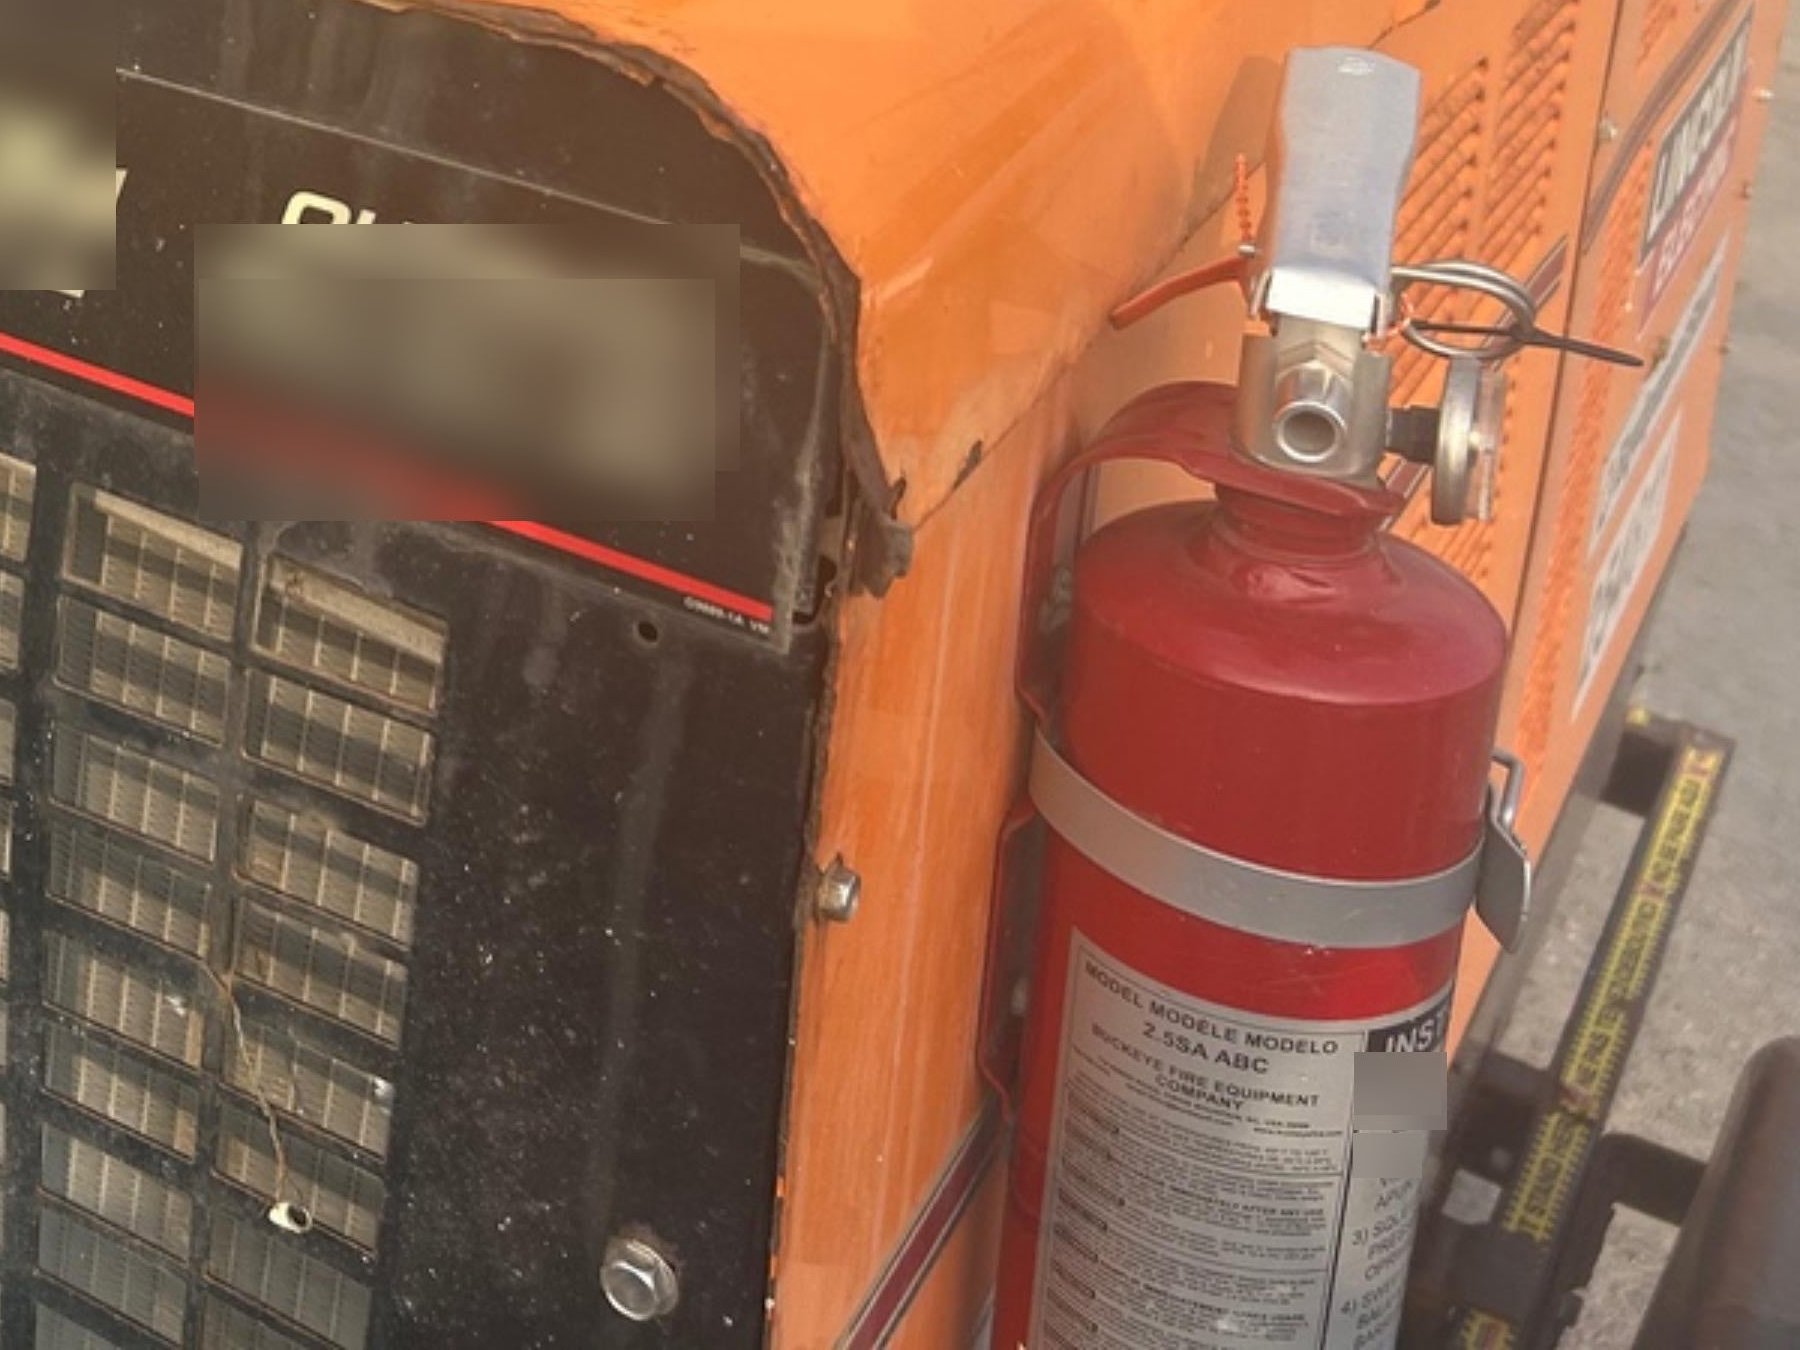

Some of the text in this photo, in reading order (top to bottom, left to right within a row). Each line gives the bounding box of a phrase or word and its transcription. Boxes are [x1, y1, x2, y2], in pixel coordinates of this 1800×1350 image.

[1085, 959, 1143, 1009] MODEL
[1244, 1031, 1339, 1054] MODELO
[1092, 1023, 1163, 1071] BUCKEYE
[1168, 1064, 1207, 1088] FIRE
[1213, 1081, 1320, 1108] EQUIPMENT
[1155, 1075, 1244, 1112] COMPANY
[1214, 1051, 1270, 1075] ABC
